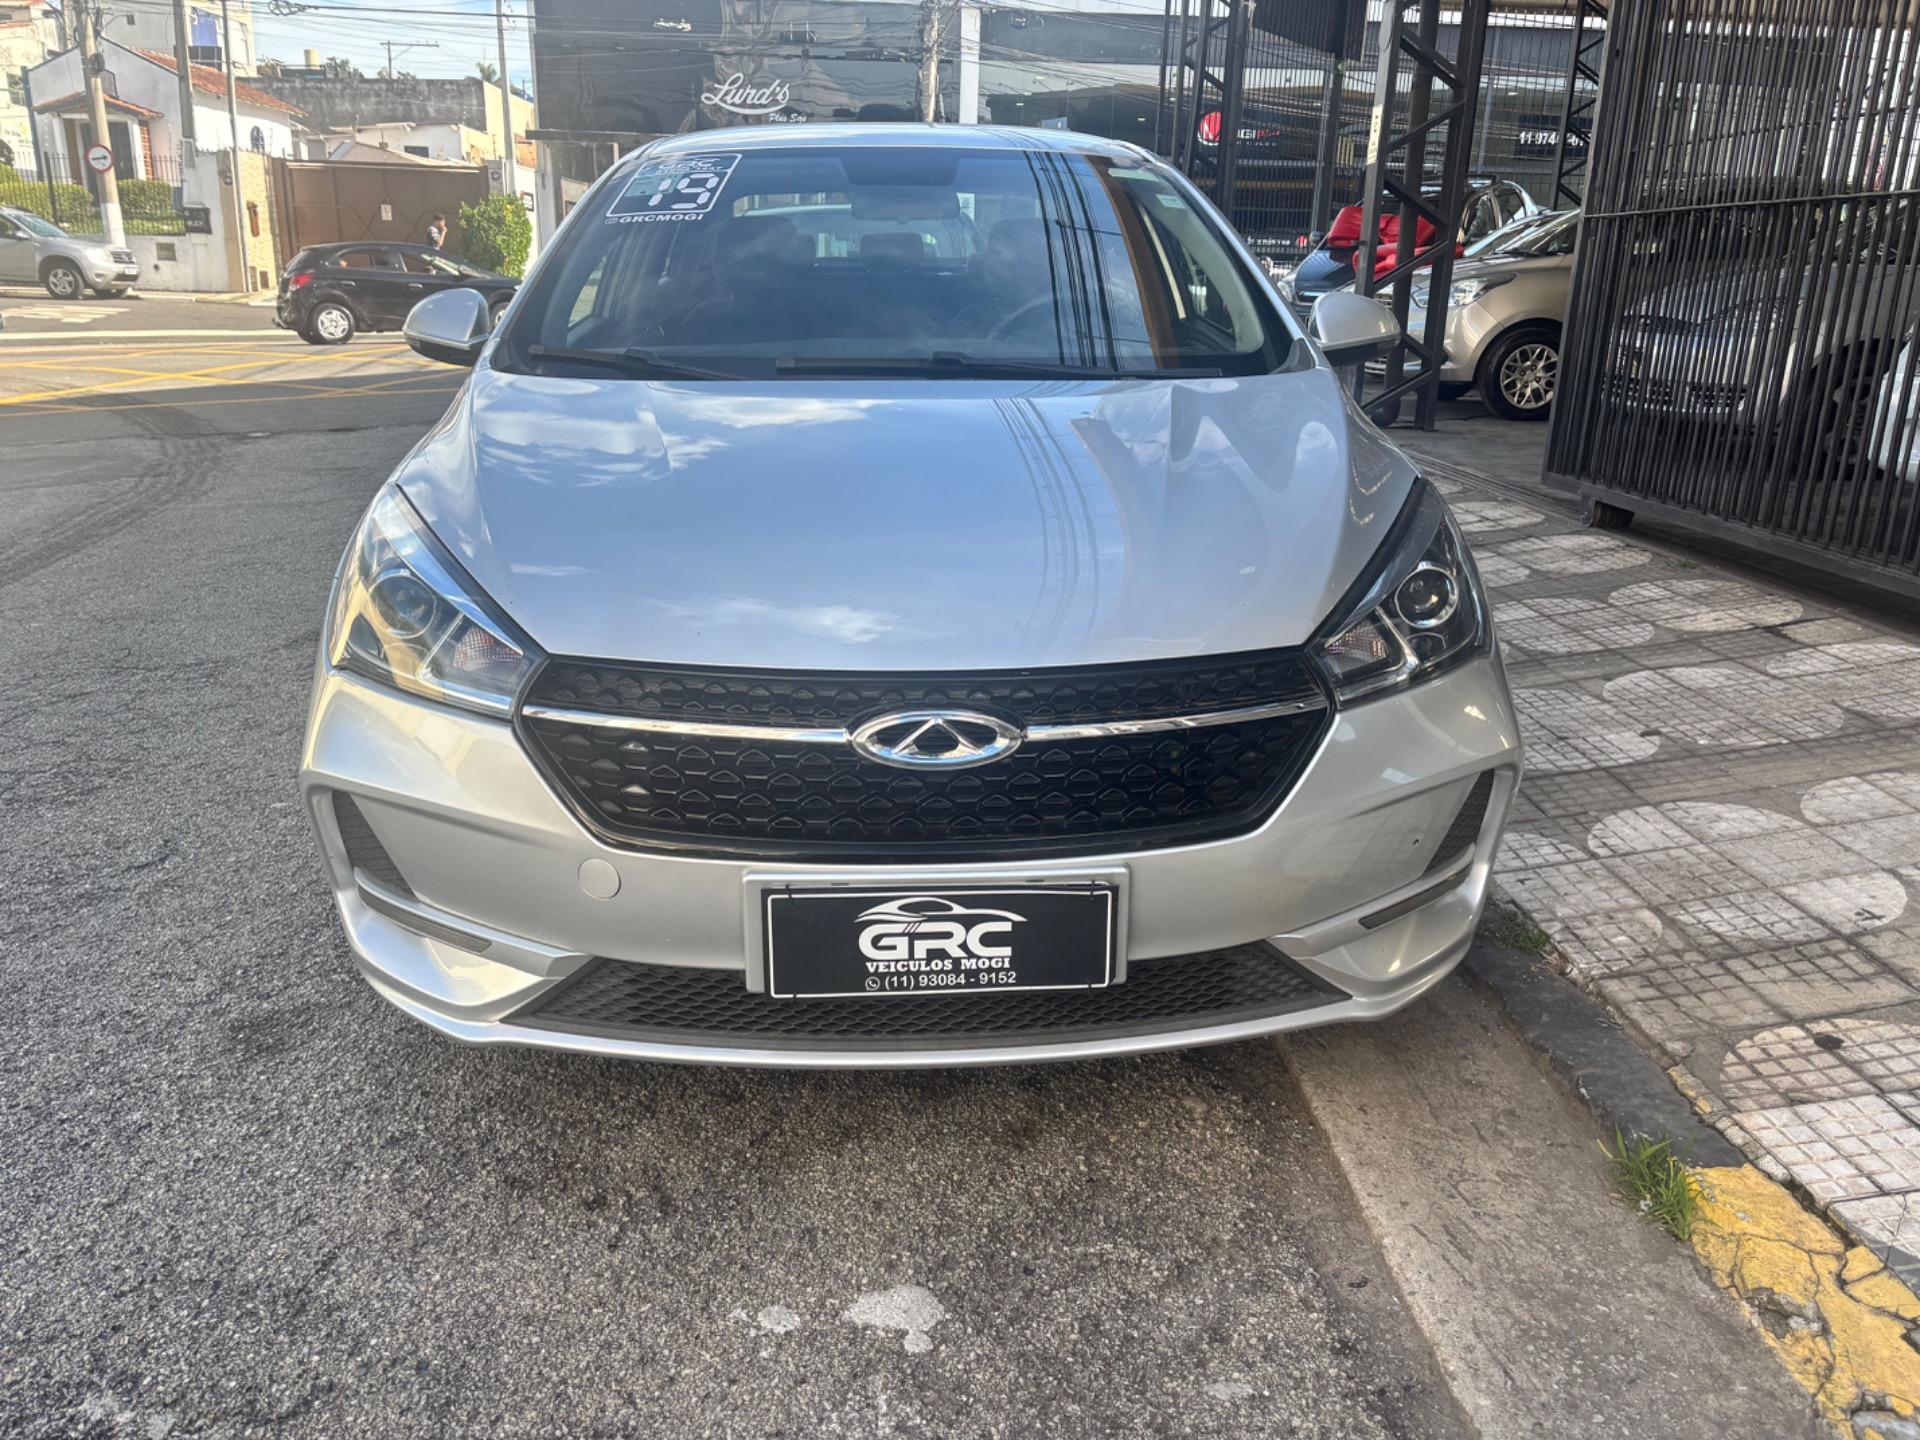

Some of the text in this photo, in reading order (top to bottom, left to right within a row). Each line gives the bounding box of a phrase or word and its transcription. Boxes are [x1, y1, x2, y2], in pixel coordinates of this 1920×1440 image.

[648, 172, 720, 210] 19
[858, 921, 1012, 960] GRC
[865, 957, 1011, 973] VEICULOS MOGI
[884, 975, 914, 990] (11)
[918, 973, 966, 987] 93084
[979, 971, 1017, 985] 9152
